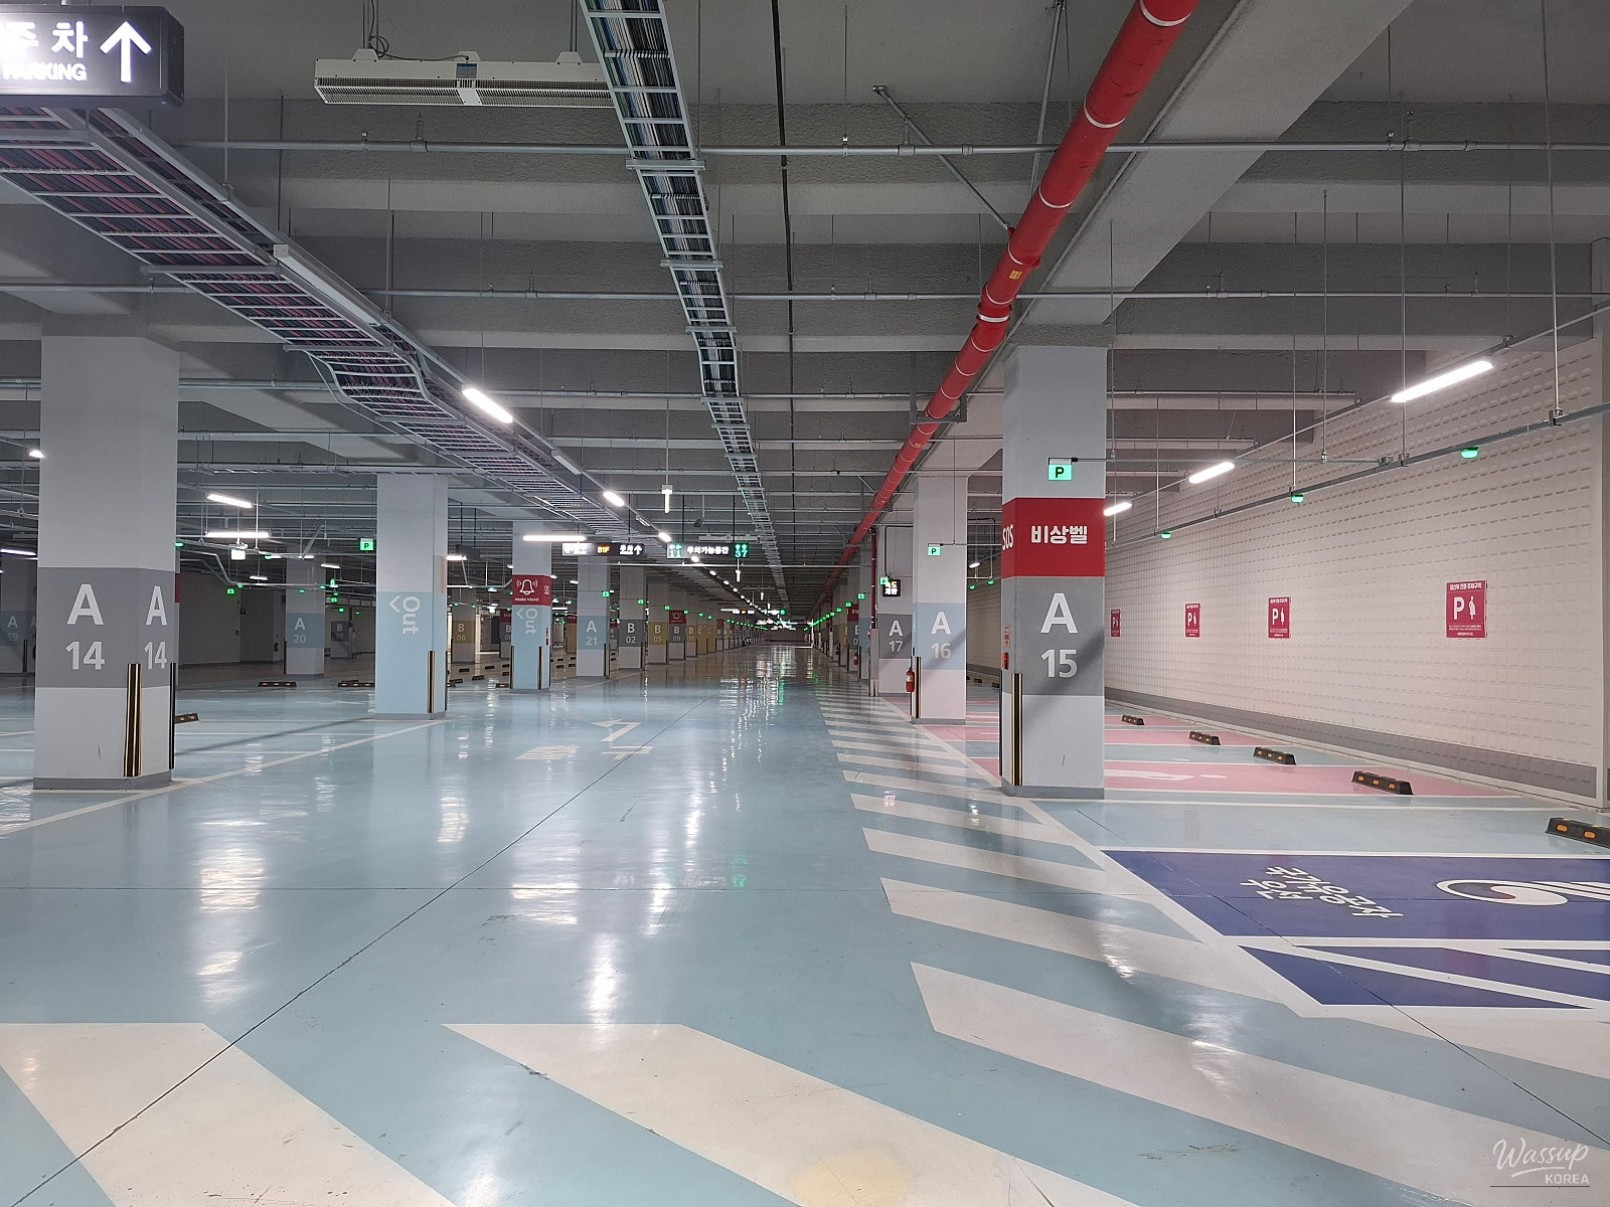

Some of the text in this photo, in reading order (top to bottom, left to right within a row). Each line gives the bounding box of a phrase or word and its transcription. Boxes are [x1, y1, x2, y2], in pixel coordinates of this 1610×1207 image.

[1055, 466, 1065, 478] P
[1002, 523, 1014, 551] SOS
[1030, 525, 1088, 545] 비상벨
[66, 583, 105, 625] A
[145, 585, 168, 626] A
[1040, 592, 1079, 634] A
[1453, 596, 1465, 620] P
[7, 615, 18, 628] A
[294, 617, 306, 631] A
[402, 596, 421, 636] Out
[525, 608, 538, 635] Out
[931, 611, 952, 635] A
[1271, 607, 1279, 626] P
[336, 623, 343, 632] B
[458, 623, 465, 631] B
[586, 620, 597, 633] A
[627, 622, 635, 634] B
[654, 625, 661, 634] B
[673, 626, 680, 634] B
[889, 620, 904, 637] A
[293, 634, 307, 644] 20
[586, 636, 598, 646] 21
[626, 636, 636, 644] 02
[889, 640, 904, 653] 17
[65, 641, 105, 670] 14
[144, 641, 167, 670] 14
[931, 642, 952, 659] 16
[1041, 649, 1078, 678] 15
[1239, 879, 1314, 900] 우선
[1265, 866, 1404, 918] 국가유공자
